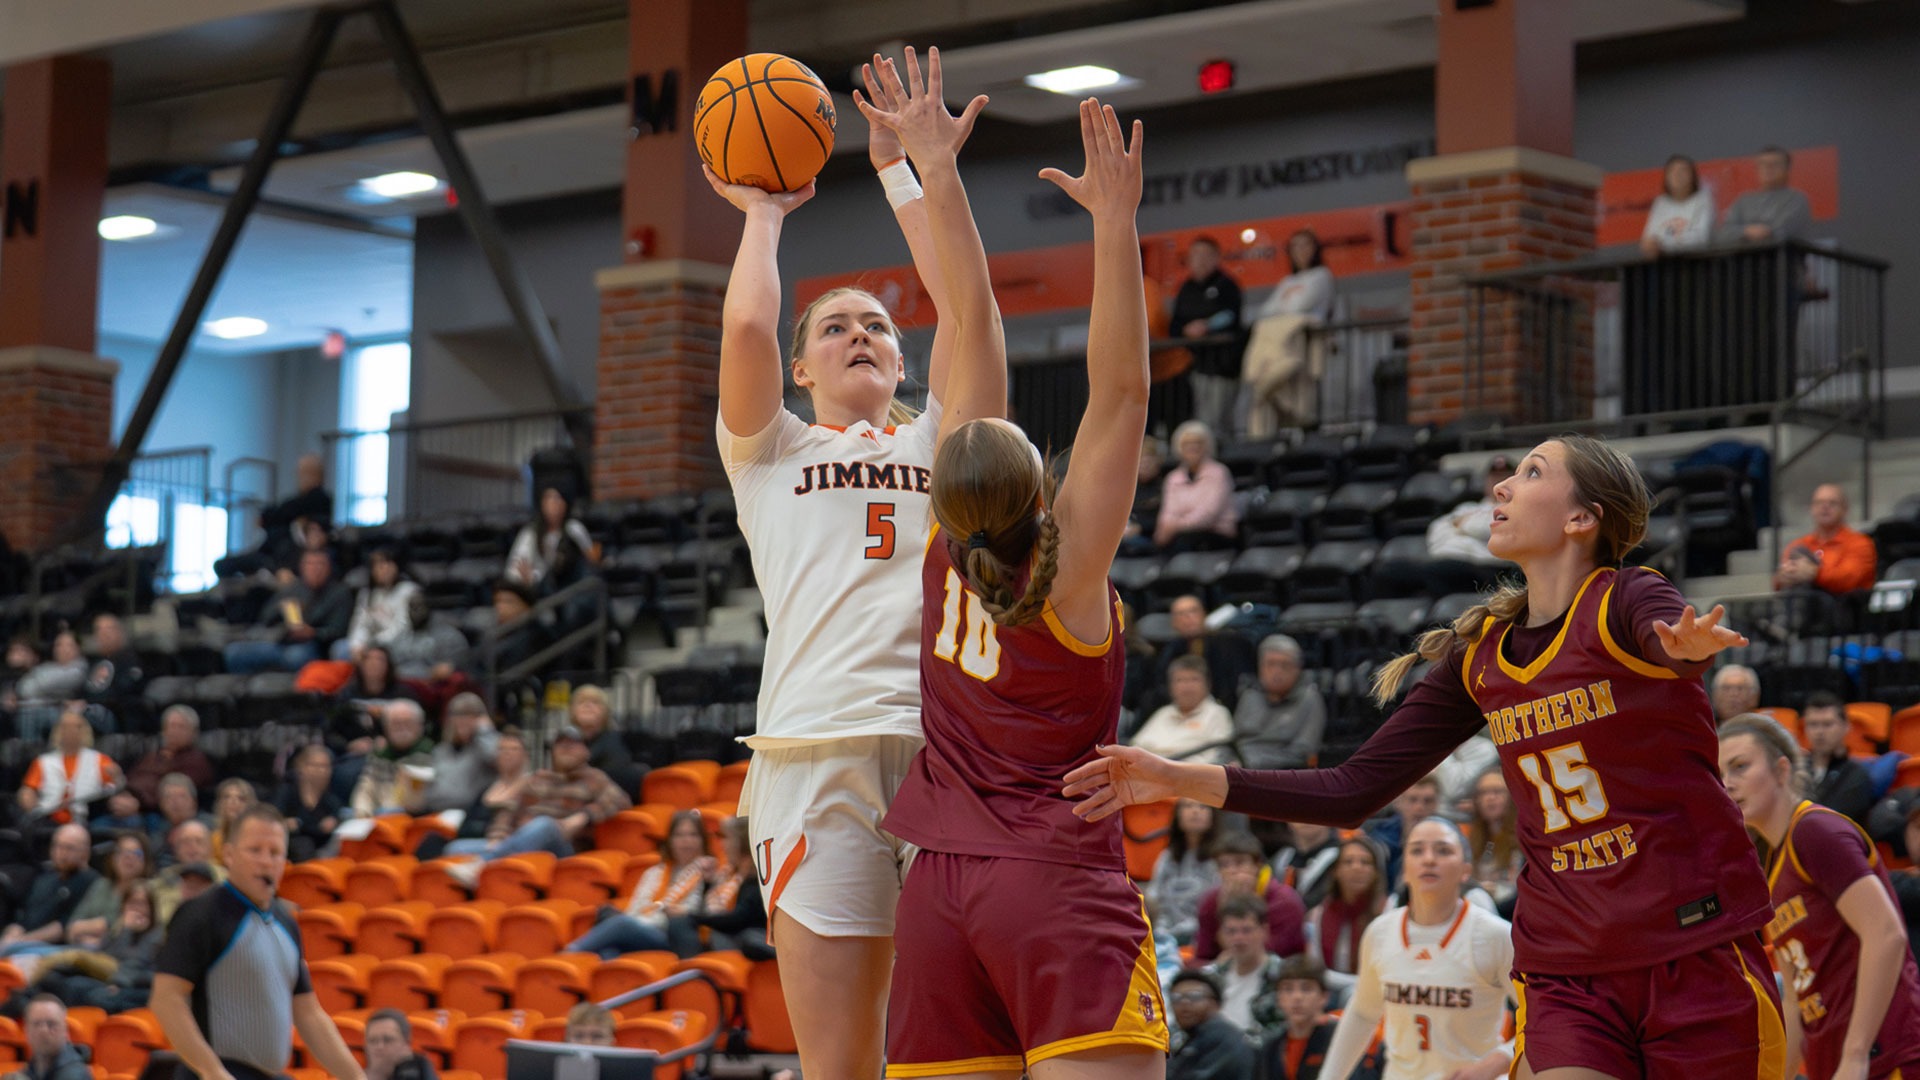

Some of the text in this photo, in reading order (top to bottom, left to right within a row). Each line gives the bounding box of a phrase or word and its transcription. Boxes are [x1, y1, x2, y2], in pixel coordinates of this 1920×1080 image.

[6, 178, 38, 238] N
[794, 461, 932, 496] JIMMIE
[864, 502, 896, 560] 5
[933, 565, 1001, 682] 10
[1517, 741, 1610, 834] 15
[1551, 823, 1638, 873] STATE
[1414, 1013, 1432, 1052] 3
